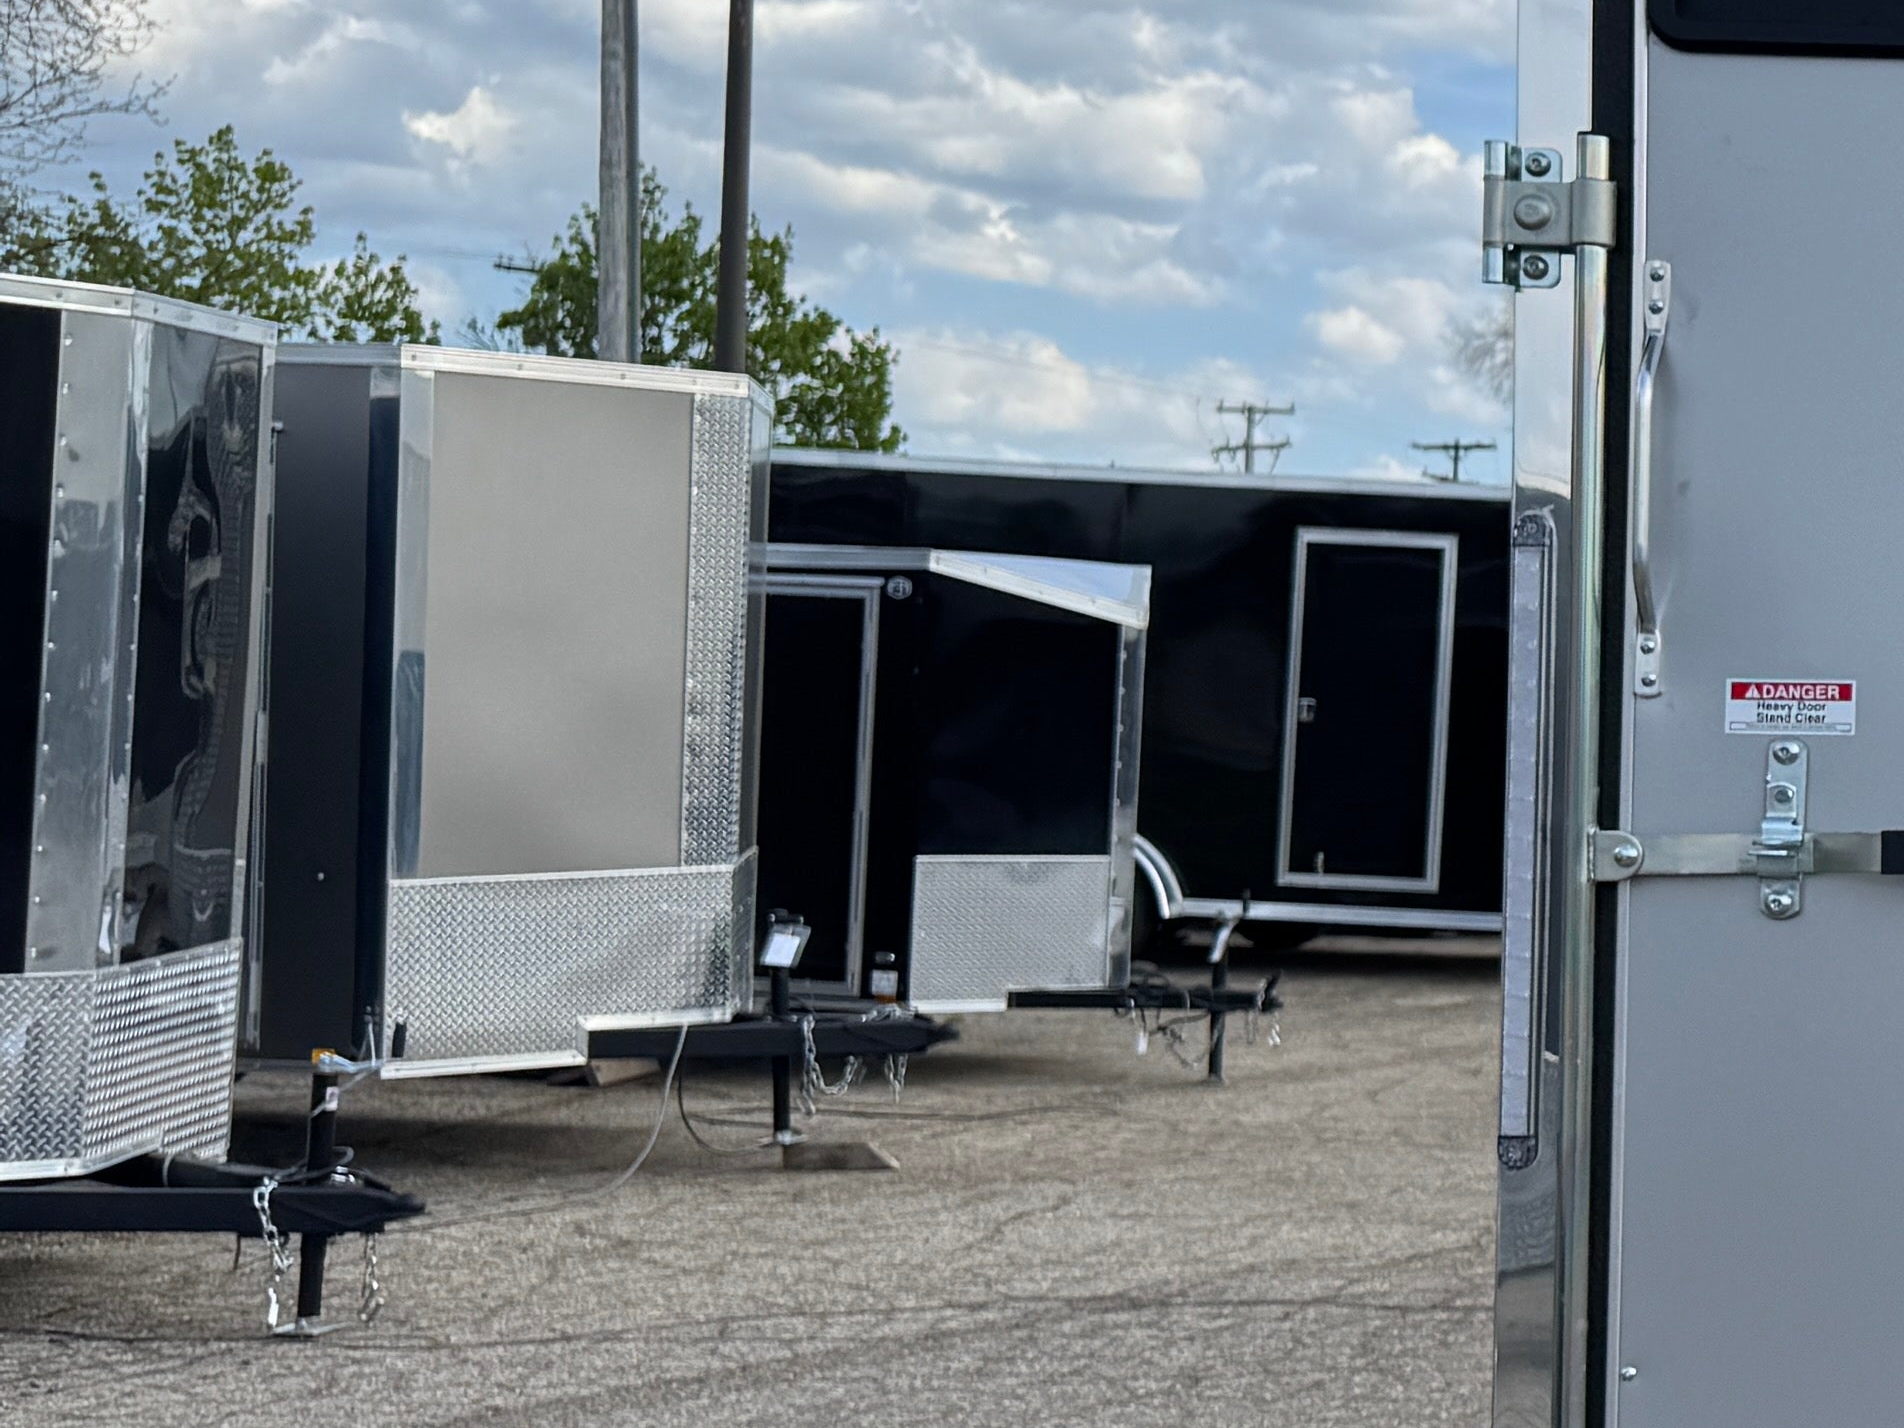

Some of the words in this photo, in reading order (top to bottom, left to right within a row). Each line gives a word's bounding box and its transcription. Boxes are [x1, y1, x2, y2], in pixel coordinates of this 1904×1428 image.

[1763, 684, 1840, 699] DANGER
[1757, 702, 1794, 716] Heavy
[1798, 702, 1826, 711] Door
[1757, 713, 1791, 723] Stand
[1795, 713, 1826, 723] Clear
